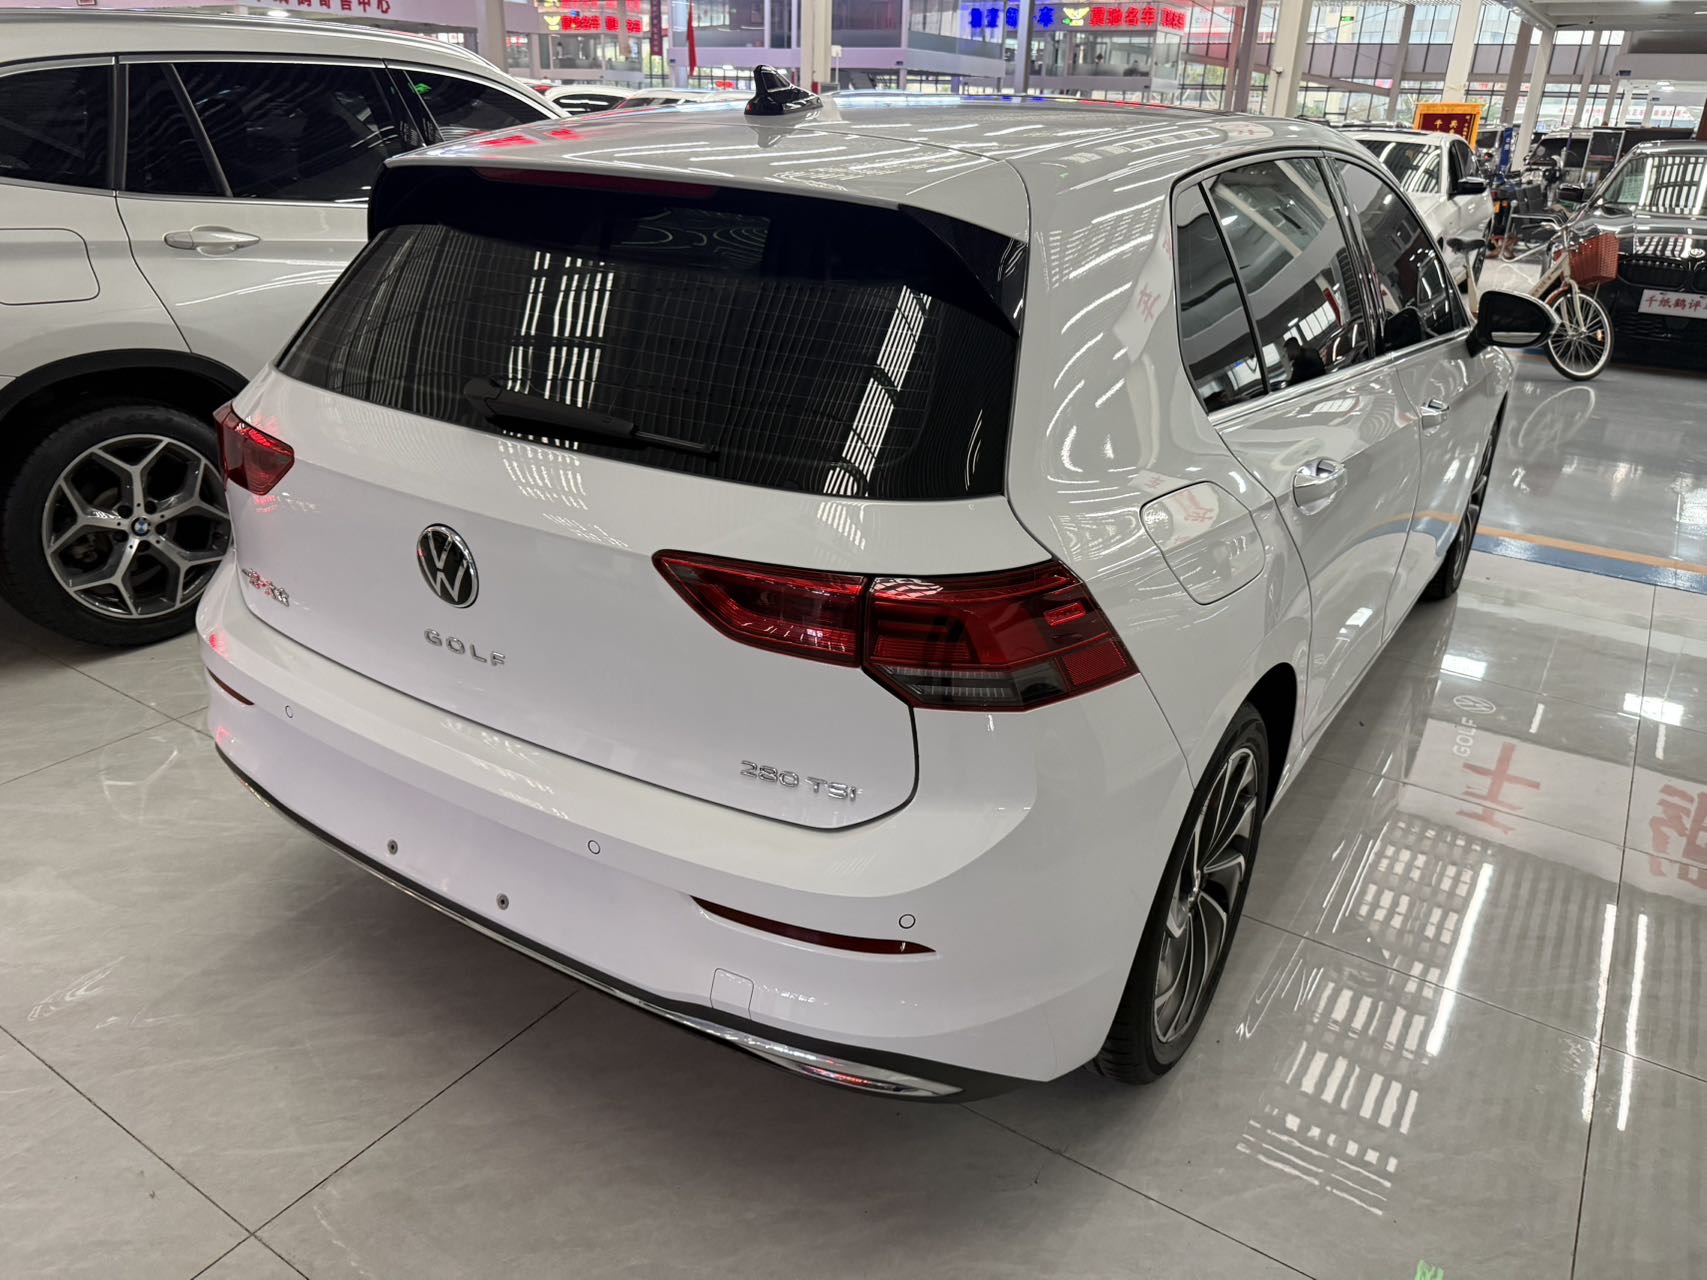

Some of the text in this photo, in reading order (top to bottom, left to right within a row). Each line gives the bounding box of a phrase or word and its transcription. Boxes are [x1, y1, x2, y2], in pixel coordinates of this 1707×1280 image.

[423, 627, 506, 667] GOLF
[1451, 716, 1479, 759] GOLF
[739, 759, 800, 788] 280
